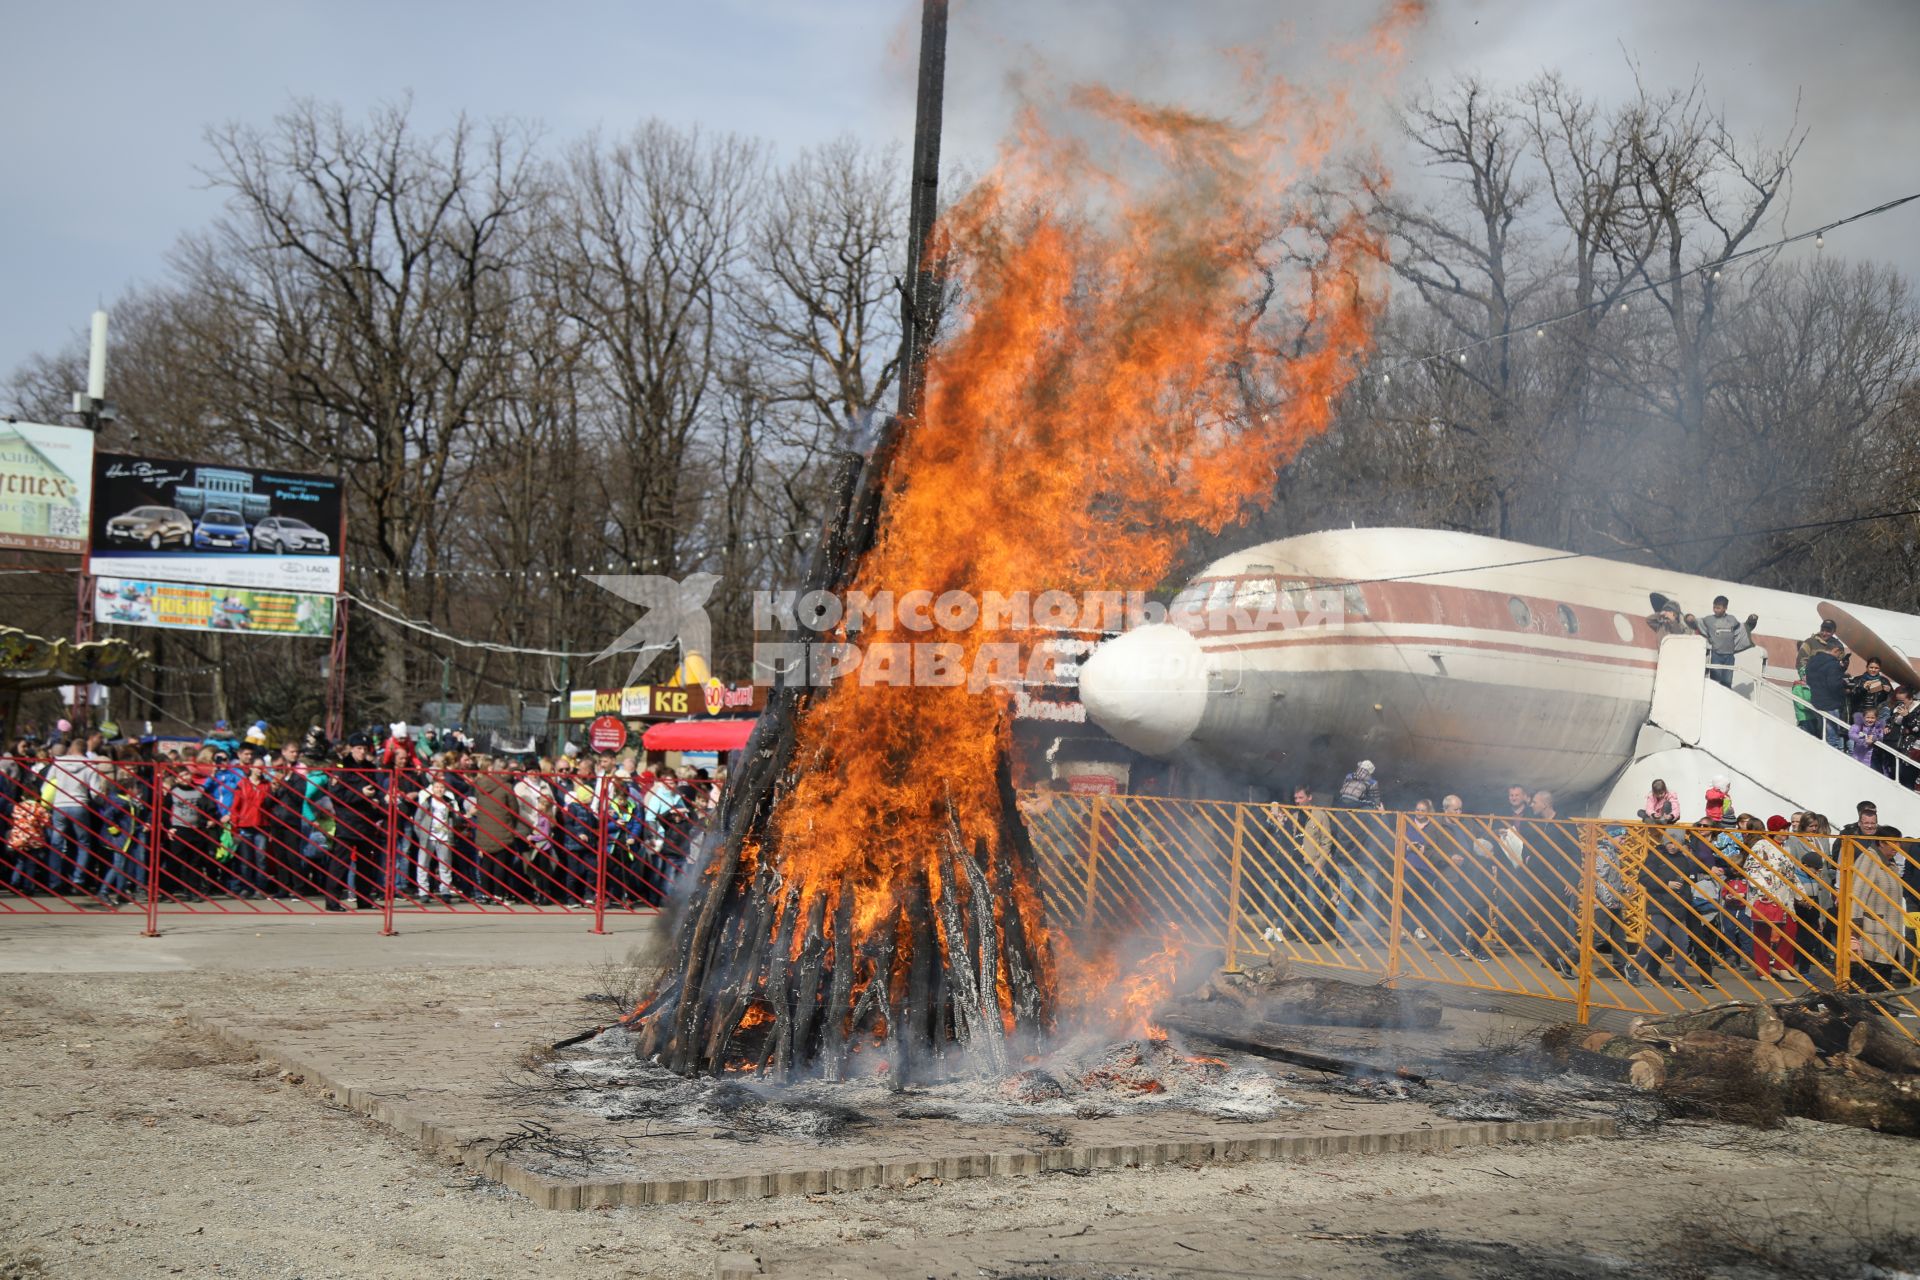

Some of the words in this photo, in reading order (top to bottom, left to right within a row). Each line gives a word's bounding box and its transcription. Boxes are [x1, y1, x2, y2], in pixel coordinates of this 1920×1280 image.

[306, 565, 330, 573] LADA
[152, 596, 217, 617] ТЮБИНГ
[655, 691, 688, 713] КВ
